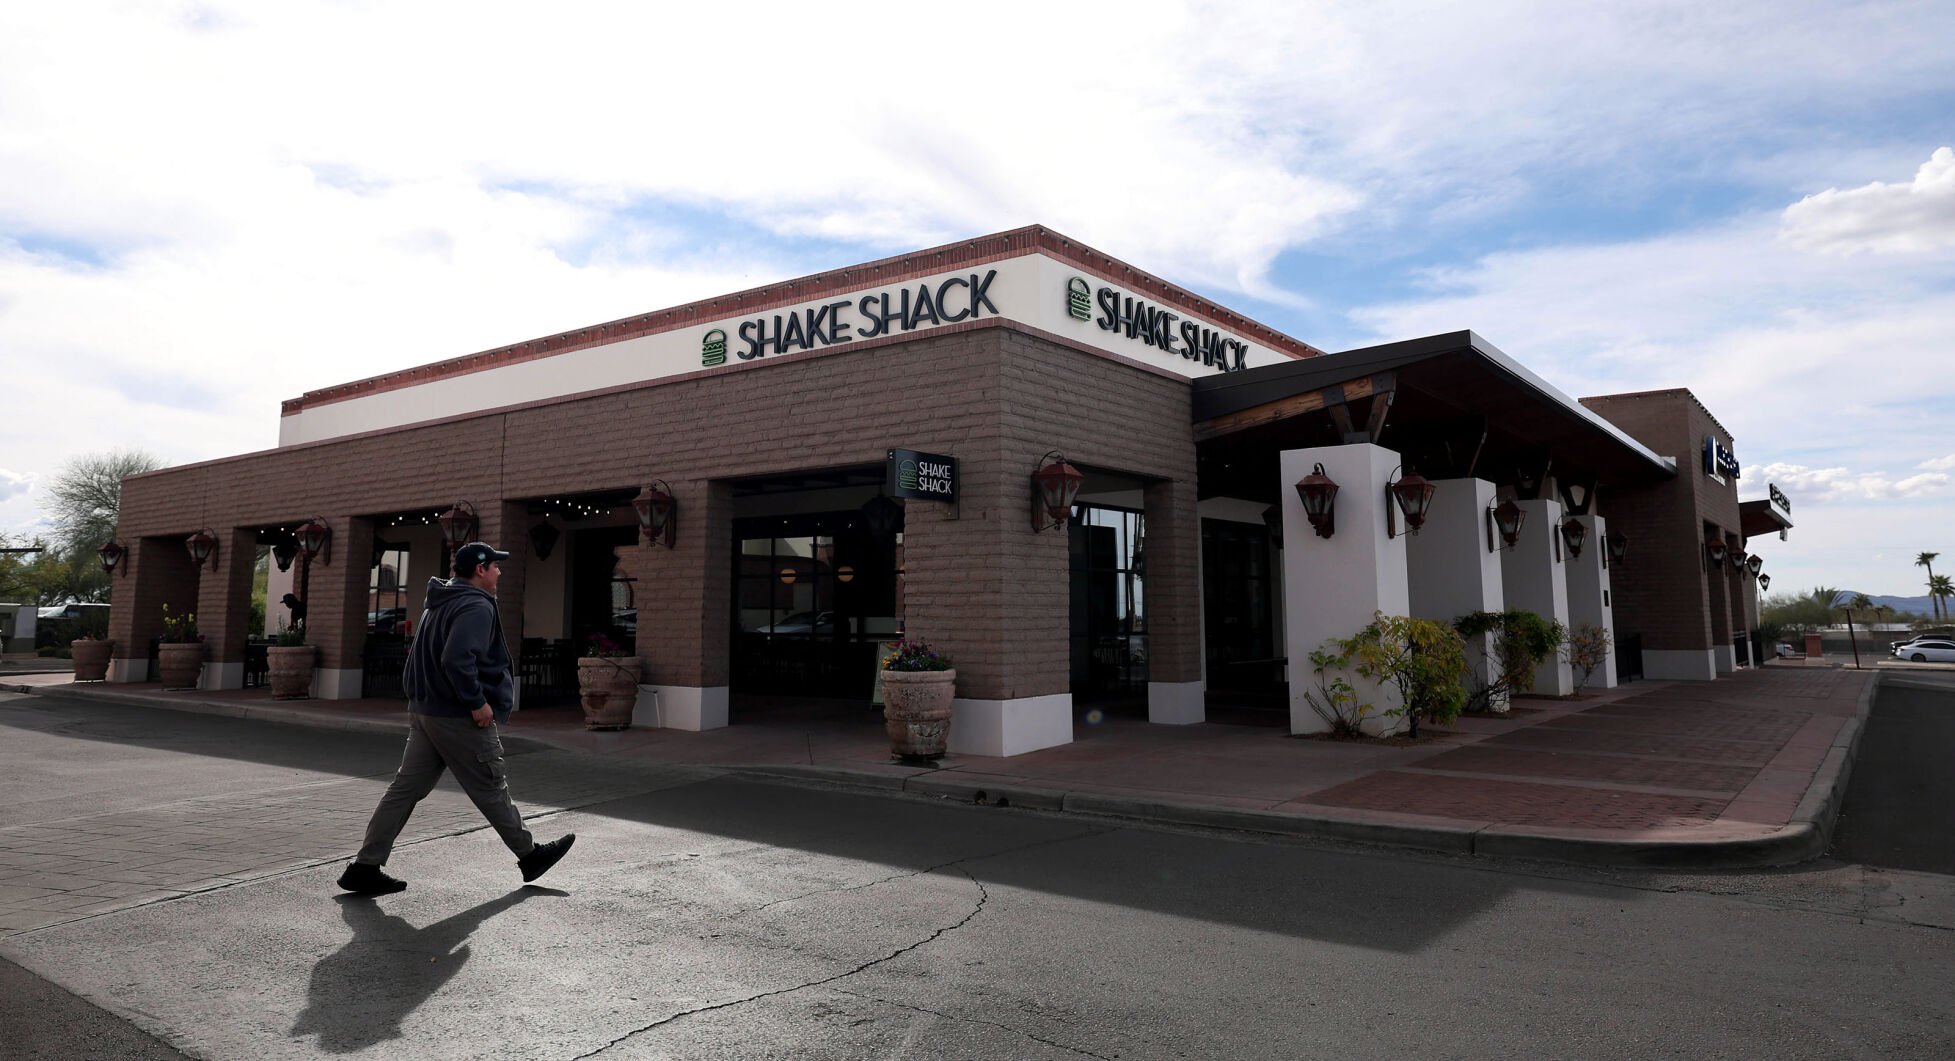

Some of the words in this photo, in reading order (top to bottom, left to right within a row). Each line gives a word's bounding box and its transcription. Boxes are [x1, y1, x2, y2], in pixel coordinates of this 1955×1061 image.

[737, 301, 852, 360] SHAKE
[857, 269, 999, 338] SHACK
[1097, 287, 1180, 354] SHAKE
[1180, 321, 1249, 373] SHACK
[918, 461, 951, 479] SHAKE
[918, 477, 952, 494] SHACK
